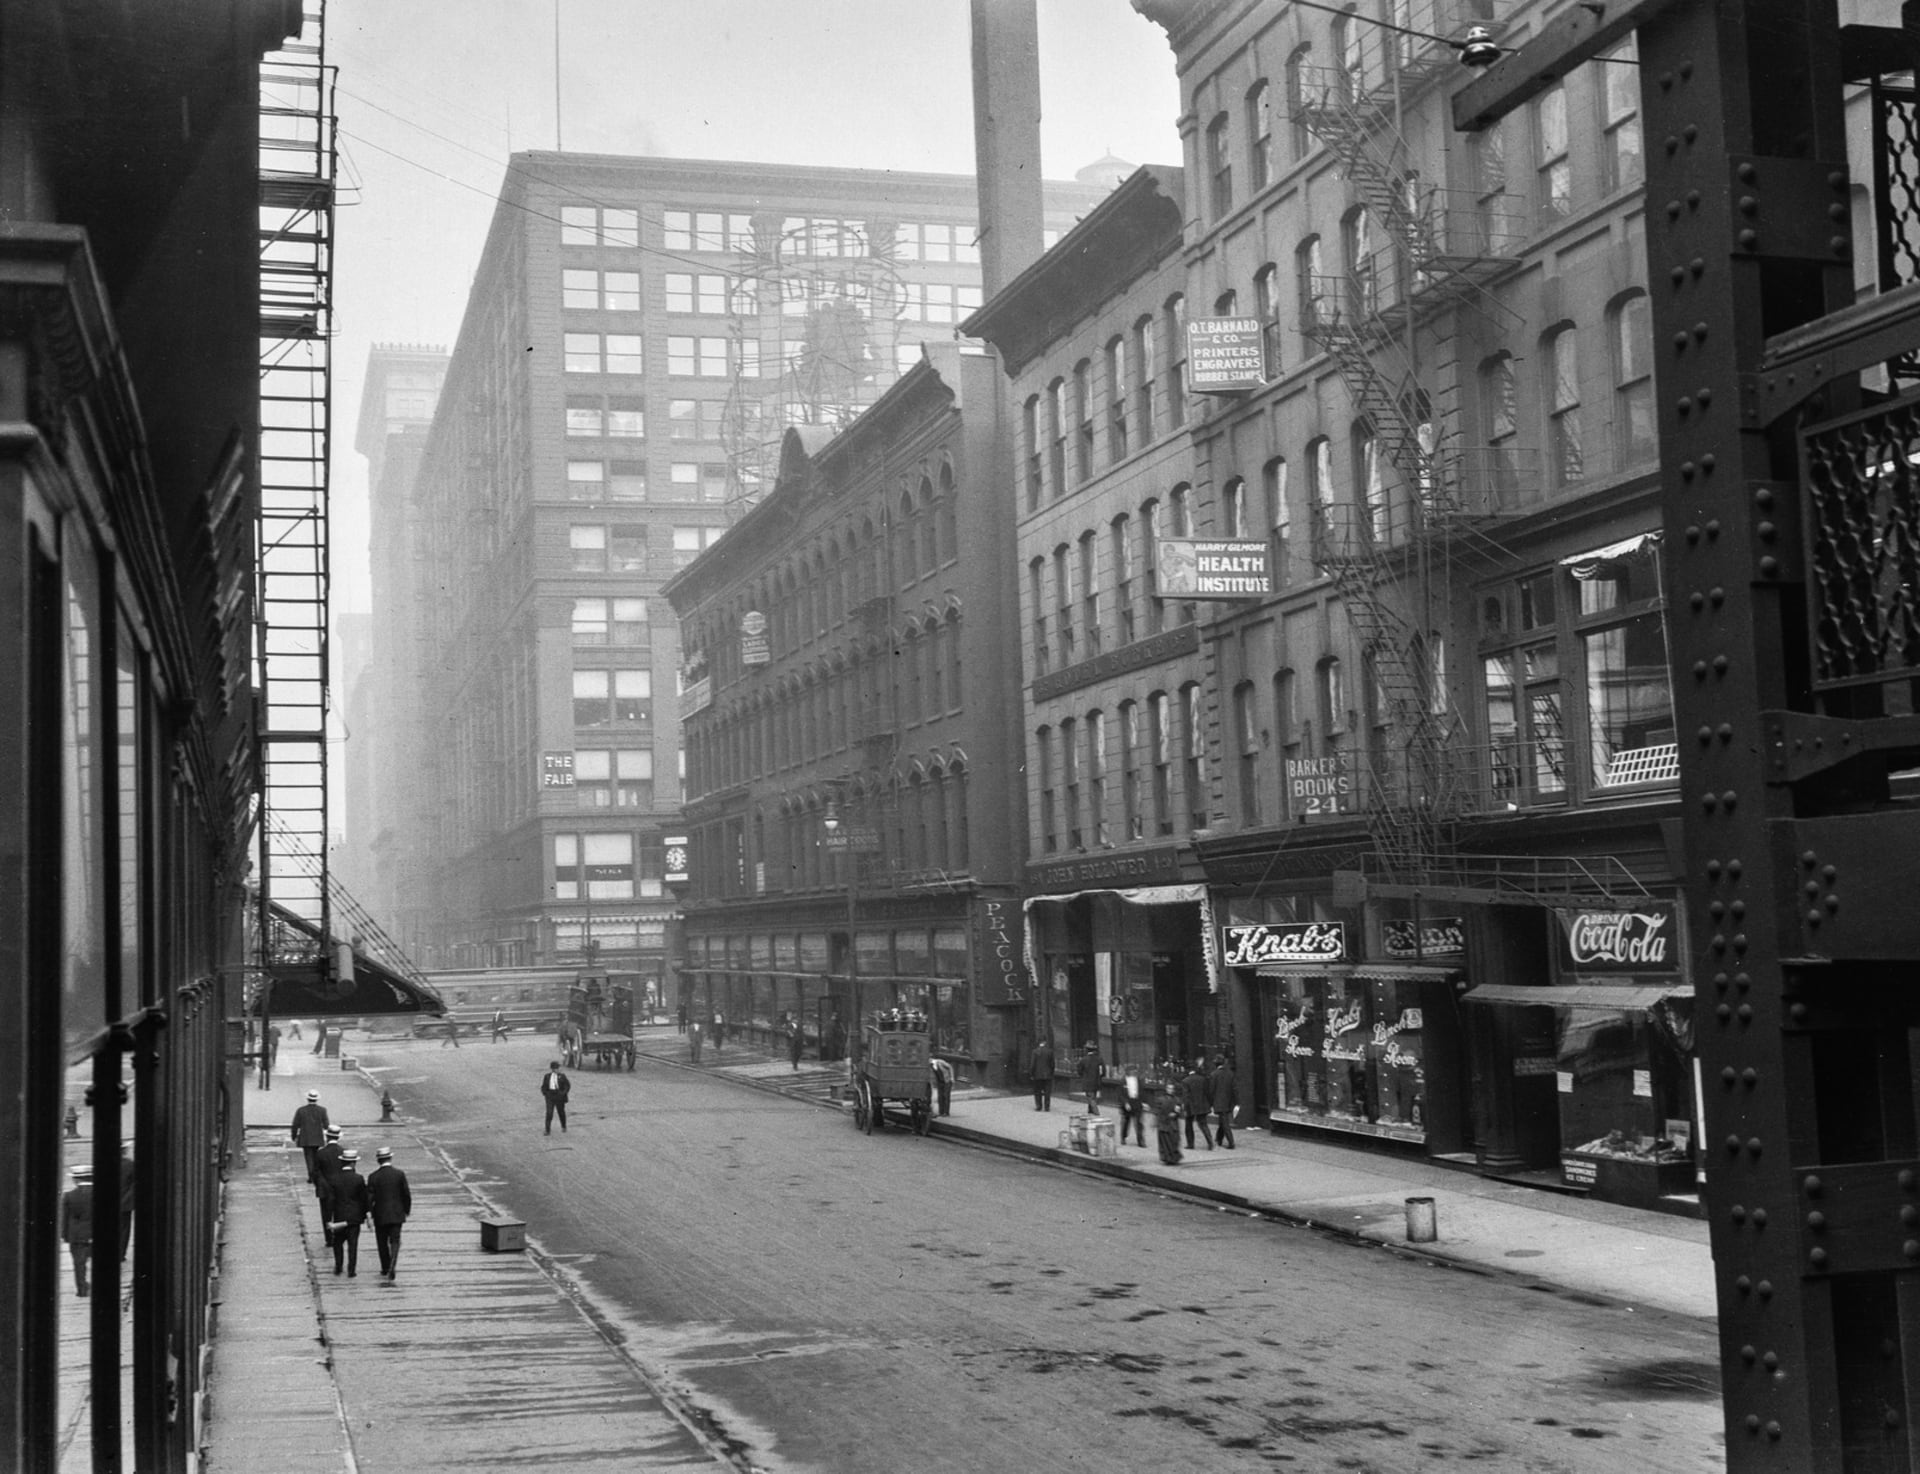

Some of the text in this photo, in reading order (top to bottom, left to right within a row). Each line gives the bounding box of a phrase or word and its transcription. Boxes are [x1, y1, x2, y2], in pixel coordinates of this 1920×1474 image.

[1208, 320, 1259, 333] BARNARD
[1212, 334, 1241, 344] & CO.
[1193, 346, 1259, 358] PRINTERS
[1194, 357, 1261, 370] ENGRAVERS
[1195, 370, 1262, 382] RUBBER STAMPS
[1195, 543, 1266, 552] HARRY GILMORE
[1198, 557, 1264, 572] HEALTH
[1198, 577, 1269, 592] INSTITUTE
[544, 756, 572, 768] THE
[544, 773, 574, 785] FAIR
[1294, 776, 1349, 797] BOOKS
[1590, 913, 1621, 924] DRINK
[1226, 923, 1343, 963] Knab's
[985, 902, 1025, 1001] PEACOCK
[1275, 1005, 1308, 1039] Lunch
[1285, 1035, 1314, 1058] Room
[1383, 1041, 1419, 1068] Room
